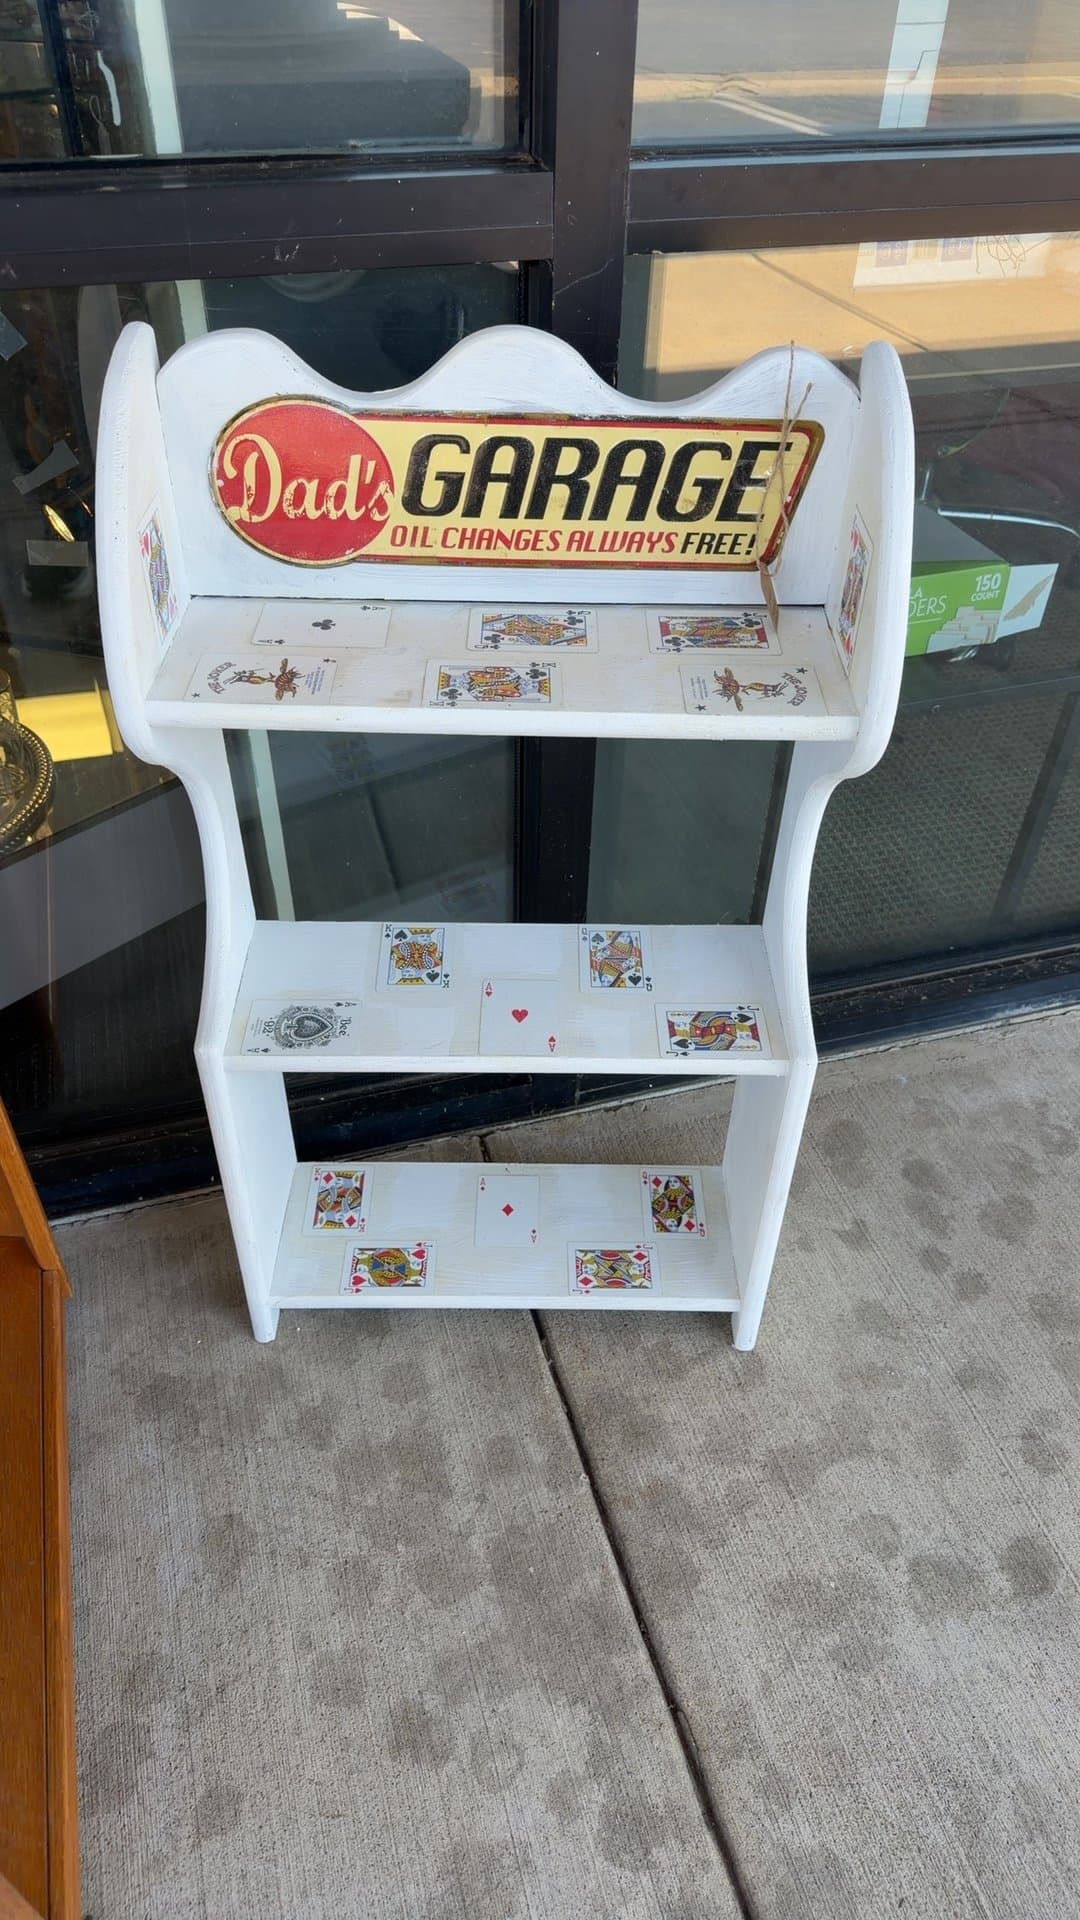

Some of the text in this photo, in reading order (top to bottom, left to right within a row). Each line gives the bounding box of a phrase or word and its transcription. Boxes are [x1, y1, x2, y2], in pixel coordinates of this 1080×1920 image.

[223, 433, 793, 522] Dad's GARAGE
[390, 525, 756, 555] OIL CHANGES ALWAYS FREE!
[975, 573, 1001, 592] 150
[971, 590, 1000, 602] COUNT
